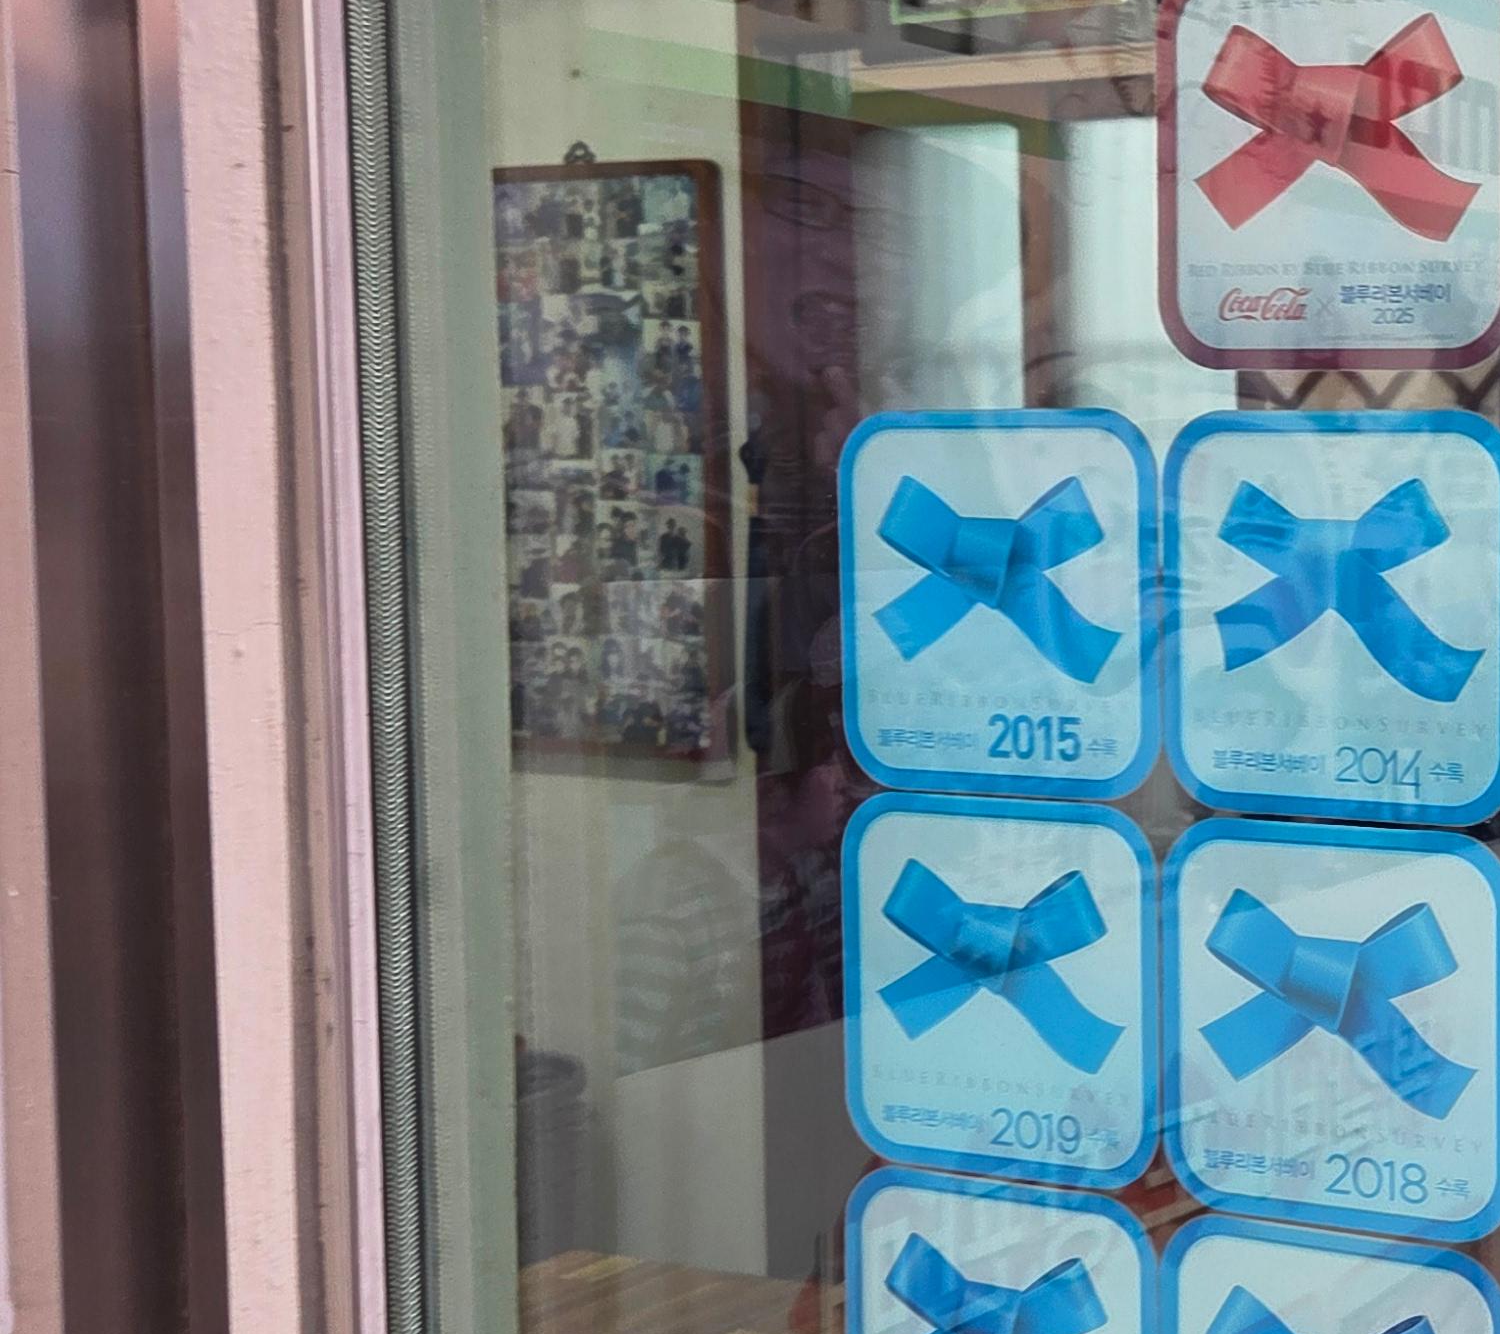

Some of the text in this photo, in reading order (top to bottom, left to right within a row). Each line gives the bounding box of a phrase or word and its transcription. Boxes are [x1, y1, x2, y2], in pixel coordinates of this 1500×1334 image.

[1340, 283, 1453, 305] 블루리본서베이
[1371, 307, 1415, 325] 2025
[986, 713, 1083, 762] 2015
[1334, 746, 1424, 799] 2014
[1428, 761, 1466, 784] 수록
[989, 1107, 1083, 1155] 2019
[1324, 1153, 1429, 1205] 2018
[1434, 1177, 1471, 1198] 수록
